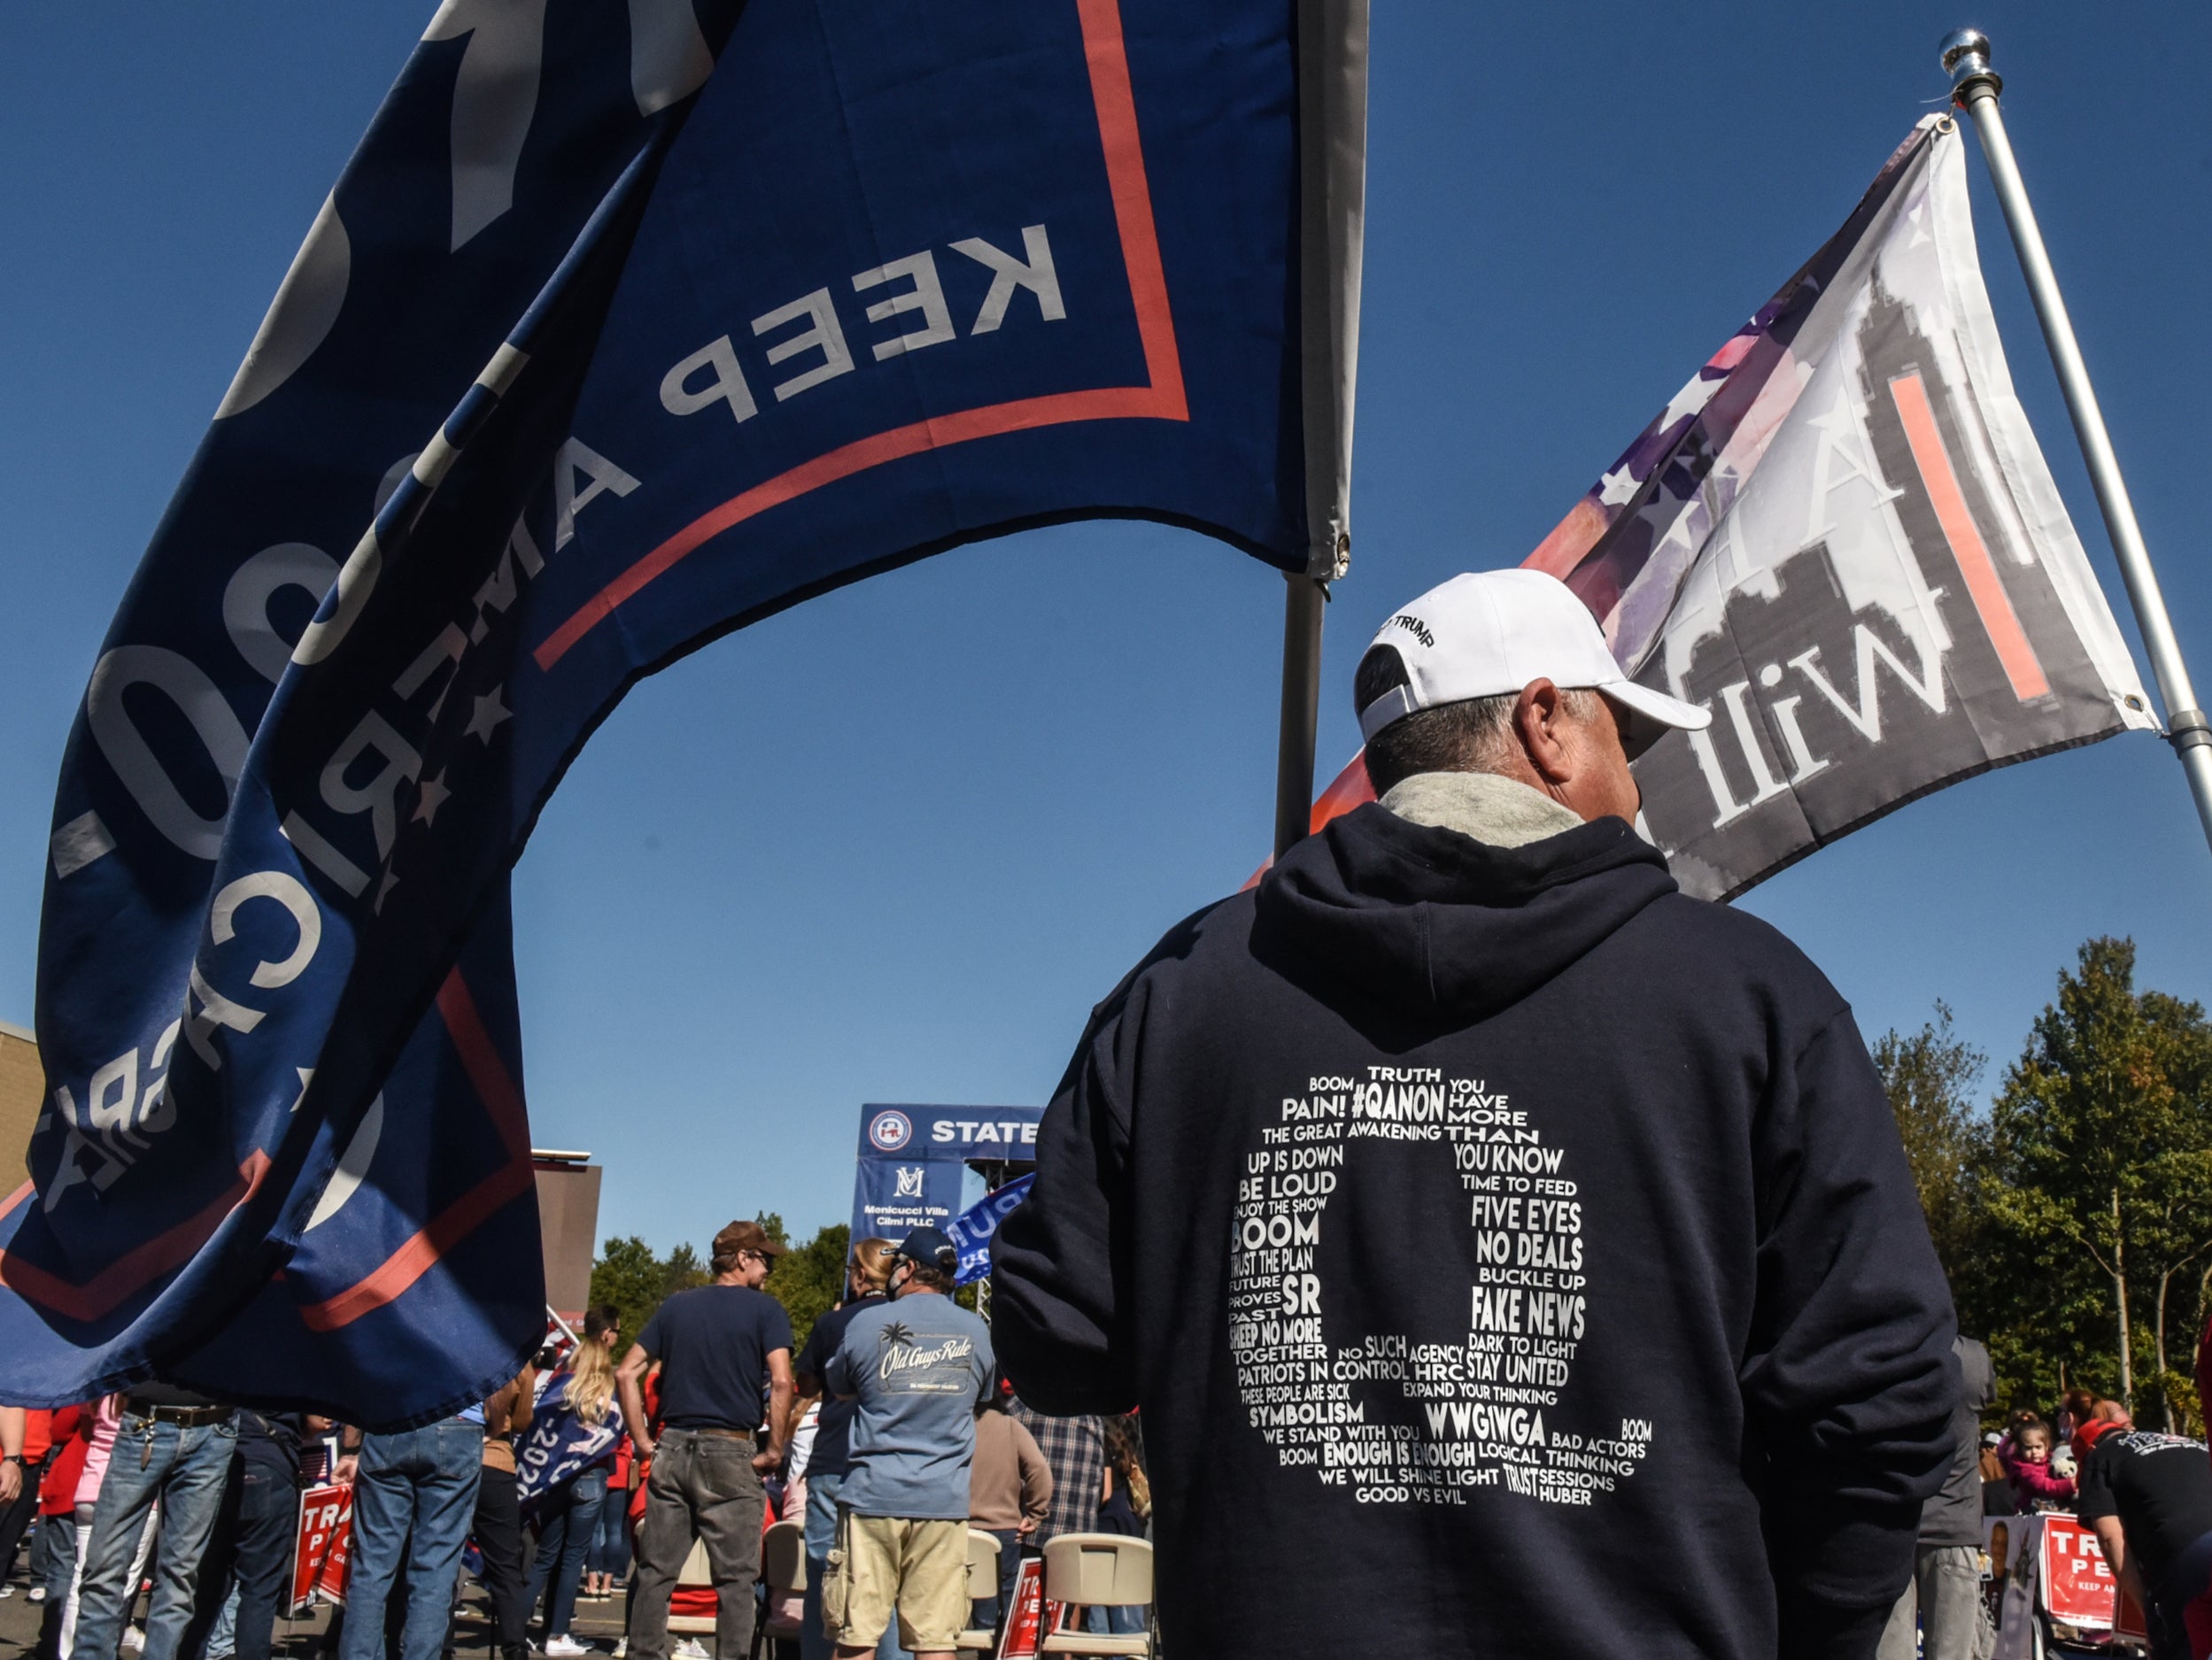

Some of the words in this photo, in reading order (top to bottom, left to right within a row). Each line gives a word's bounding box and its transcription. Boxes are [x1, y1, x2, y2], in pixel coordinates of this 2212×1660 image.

[1396, 615, 1435, 648] TRUMP
[1310, 1077, 1354, 1092] BOOM
[1367, 1066, 1442, 1083] TRUTH
[1450, 1079, 1485, 1093] YOU
[1282, 1095, 1346, 1121] PAIN!
[1351, 1083, 1445, 1122] #QANON
[1449, 1093, 1508, 1109] HAVE
[1447, 1109, 1528, 1126] MORE
[1262, 1127, 1290, 1144] THE
[1294, 1123, 1343, 1141] GREAT
[1347, 1121, 1442, 1140] AWAKENING
[1443, 1126, 1539, 1145] THAN
[1248, 1152, 1271, 1174] UP
[1275, 1150, 1288, 1171] IS
[1292, 1145, 1342, 1170] DOWN
[1453, 1143, 1489, 1170] YOU
[1492, 1145, 1564, 1175] KNOW
[1240, 1177, 1264, 1202] BE
[1271, 1171, 1336, 1198] LOUD
[1461, 1174, 1501, 1191] TIME
[1505, 1177, 1530, 1193] TO
[1535, 1177, 1577, 1196] FEED
[864, 1205, 923, 1216] Menicucci
[924, 1207, 948, 1216] Villa
[1234, 1201, 1265, 1219] ENJOY
[1268, 1200, 1289, 1215] THE
[1292, 1196, 1327, 1213] SHOW
[1472, 1195, 1521, 1230] FIVE
[1527, 1199, 1582, 1234] EYES
[906, 1217, 934, 1227] PLLC
[1232, 1210, 1319, 1254] BOOM
[1476, 1230, 1511, 1264] NO
[1517, 1232, 1583, 1271] DEALS
[1231, 1251, 1256, 1278] TRUST
[1259, 1249, 1280, 1274] THE
[1282, 1247, 1312, 1272] PLAN
[1229, 1275, 1280, 1293] FUTURE
[1480, 1267, 1554, 1288] BUCKLE
[1558, 1273, 1586, 1290] UP
[1228, 1291, 1281, 1309] PROVES
[1282, 1273, 1321, 1316] SR
[1228, 1307, 1281, 1324] PAST
[1472, 1286, 1521, 1332] FAKE
[1528, 1290, 1586, 1340] NEWS
[1229, 1323, 1258, 1350] SHEEP
[1262, 1320, 1280, 1347] NO
[1283, 1317, 1322, 1344] MORE
[1234, 1344, 1327, 1365] TOGETHER
[1338, 1347, 1362, 1360] NO
[1365, 1335, 1406, 1358] SUCH
[1409, 1344, 1464, 1363] AGENCY
[1468, 1332, 1504, 1353] DARK
[1509, 1336, 1530, 1354] TO
[1534, 1338, 1577, 1360] LIGHT
[880, 1345, 910, 1380] Old
[909, 1347, 943, 1370] Guys
[940, 1339, 971, 1361] Rule
[1466, 1351, 1501, 1381] STAY
[1505, 1355, 1568, 1386] UNITED
[1238, 1362, 1305, 1386] PATRIOTS
[1310, 1362, 1328, 1381] IN
[1333, 1360, 1410, 1381] CONTROL
[1415, 1363, 1465, 1381] HRC
[1241, 1387, 1265, 1405] THESE
[1266, 1385, 1302, 1403] PEOPLE
[1303, 1384, 1325, 1401] ARE
[1326, 1383, 1350, 1401] SICK
[1403, 1382, 1454, 1397] EXPAND
[1458, 1383, 1490, 1400] YOUR
[1493, 1386, 1558, 1406] THINKING
[1249, 1401, 1364, 1428] SYMBOLISM
[1263, 1429, 1284, 1445] WE
[1288, 1426, 1342, 1444] STAND
[1345, 1425, 1386, 1440] WITH
[1390, 1425, 1419, 1440] YOU
[1621, 1418, 1652, 1441] BOOM
[1280, 1448, 1318, 1466] BOOM
[1323, 1441, 1392, 1467] ENOUGH
[1396, 1441, 1409, 1464] IS
[1412, 1441, 1475, 1467] ENOUGH
[1551, 1432, 1582, 1449] BAD
[1586, 1438, 1646, 1459] ACTORS
[1478, 1441, 1541, 1464] LOGICAL
[1546, 1449, 1635, 1477] THINKING
[1318, 1469, 1347, 1485] WE
[1351, 1468, 1395, 1484] WILL
[1399, 1468, 1442, 1485] SHINE
[1447, 1469, 1499, 1486] LIGHT
[1503, 1463, 1538, 1497] TRUST
[1539, 1468, 1615, 1492] SESSIONS
[1356, 1486, 1409, 1503] GOOD
[1412, 1487, 1431, 1503] VS
[1434, 1488, 1466, 1504] EVIL
[1540, 1486, 1591, 1505] HUBER
[2078, 1581, 2100, 1592] KEEP
